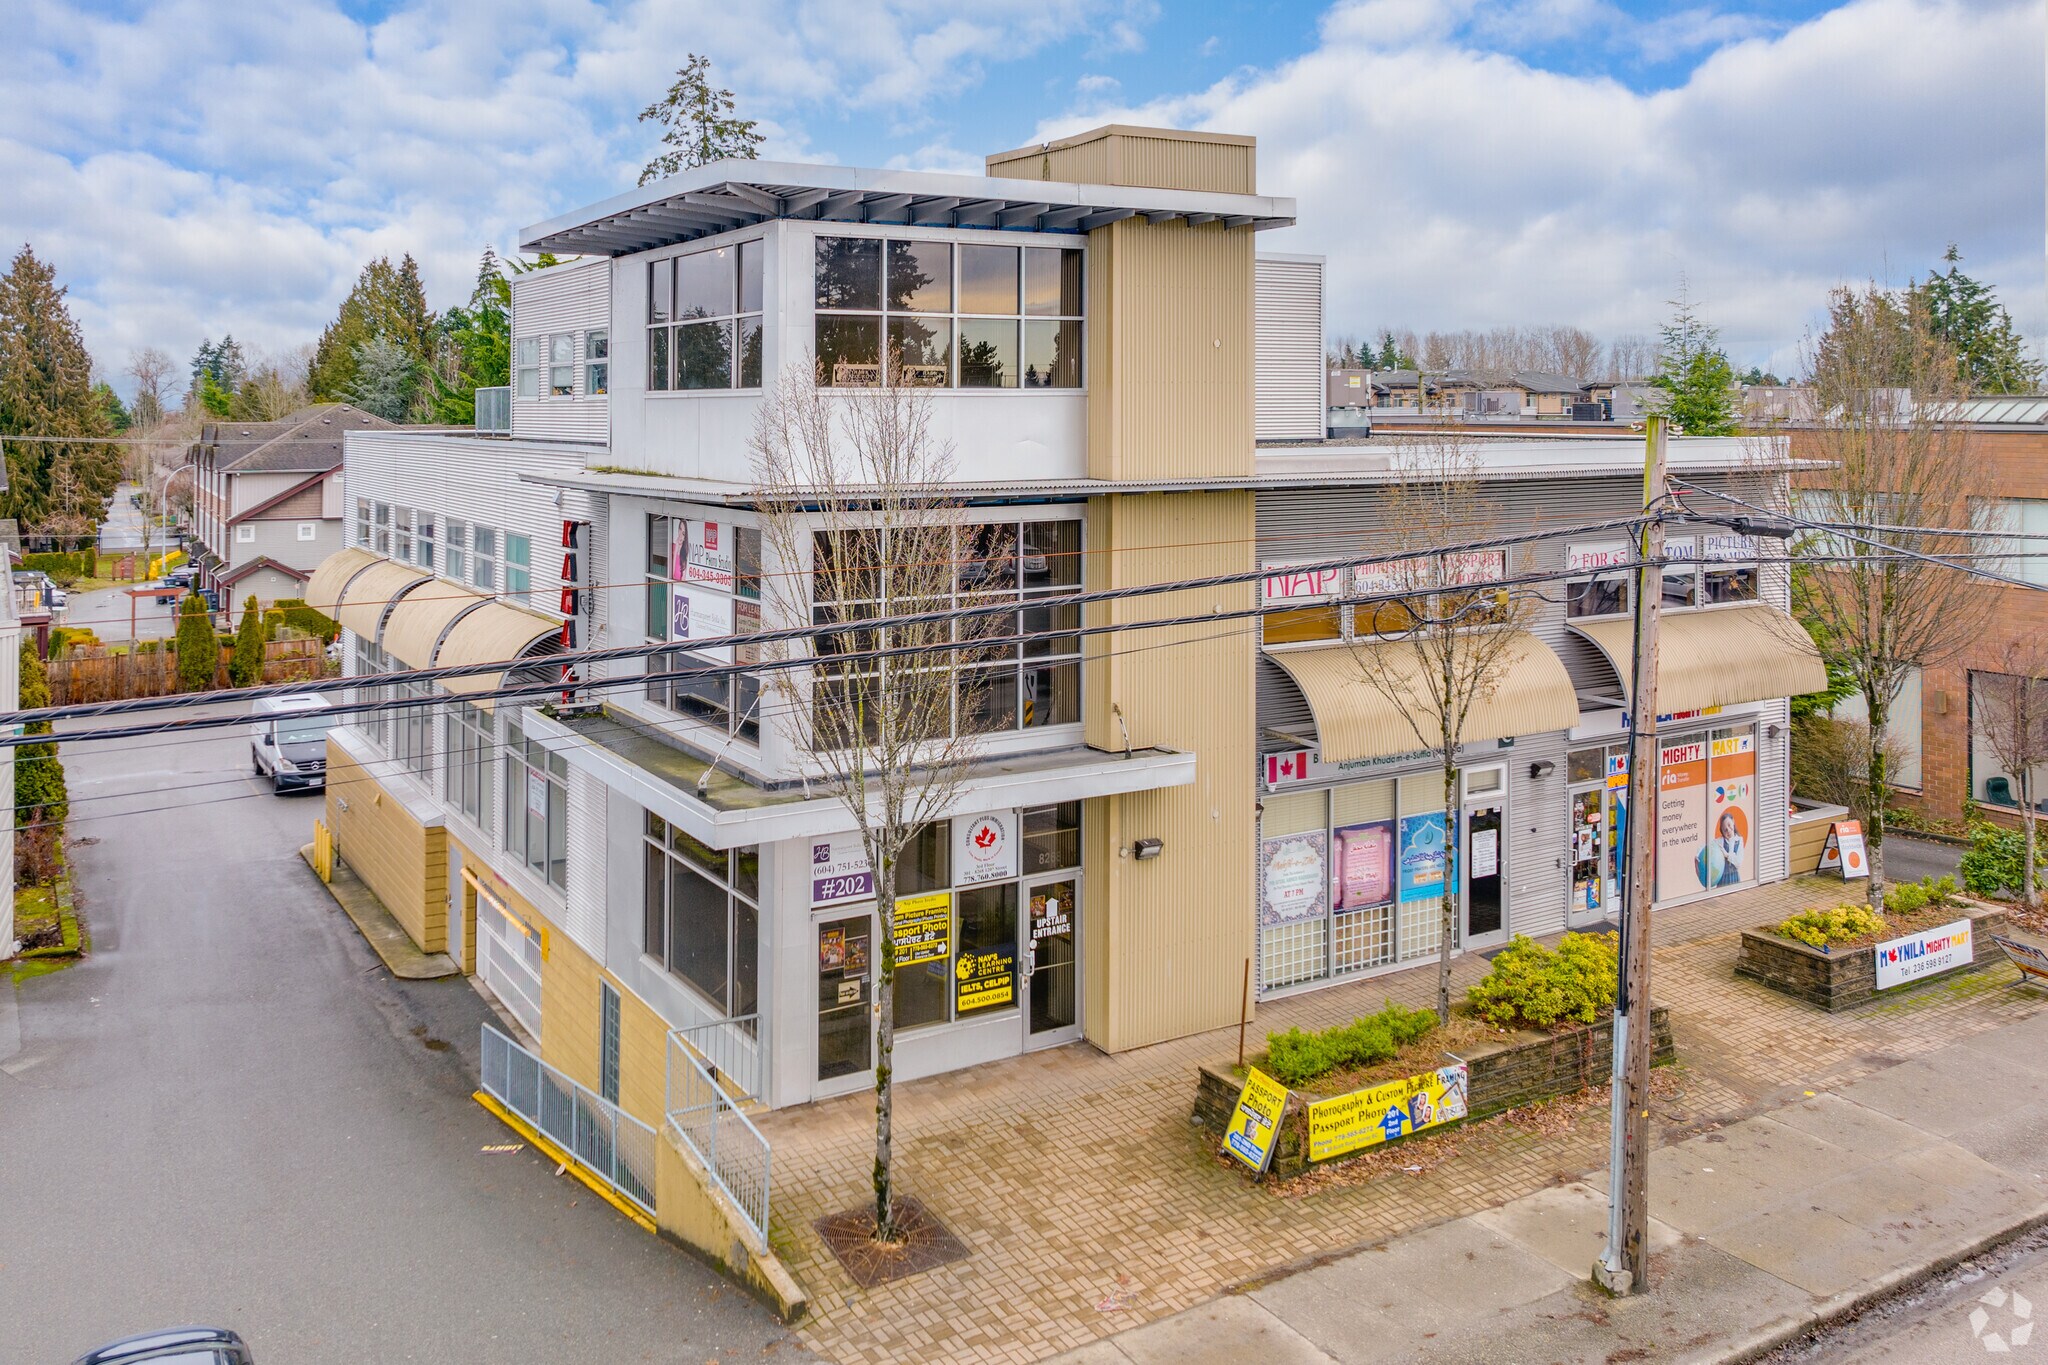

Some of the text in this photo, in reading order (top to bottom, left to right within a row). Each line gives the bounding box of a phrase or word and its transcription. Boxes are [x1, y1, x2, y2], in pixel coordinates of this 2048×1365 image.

[1664, 546, 1692, 560] TOM
[1582, 552, 1608, 569] FOR
[1613, 551, 1627, 565] $5
[1267, 566, 1338, 597] NAP
[1313, 753, 1319, 763] B
[1662, 738, 1740, 765] MIGHTY MART
[1338, 760, 1371, 771] Anjuman
[1661, 769, 1677, 785] ria
[1662, 799, 1685, 809] Getting
[1662, 813, 1682, 822] money
[1662, 822, 1697, 835] everywhere
[1840, 825, 1850, 833] ria
[1662, 833, 1698, 847] in the world
[813, 859, 868, 877] (604) 751-523
[963, 870, 1008, 883] 778.760.8000
[821, 875, 865, 899] #202
[1296, 888, 1304, 896] PM
[905, 911, 924, 919] Picture
[925, 907, 947, 917] Framing
[1036, 914, 1067, 928] UPSTAIR
[894, 926, 920, 939] ssport
[923, 922, 947, 933] Photo
[1033, 923, 1071, 939] ENTRANCE
[1926, 936, 1951, 955] MIGHTY
[1951, 930, 1969, 947] MART
[978, 953, 998, 962] NAV'S
[978, 957, 1013, 969] LEARNING
[978, 965, 1004, 976] CENTRE
[1900, 953, 1953, 976] Tel 236 598 9127
[961, 976, 1010, 994] IELTS, CELPIP
[961, 991, 1009, 1006] 604.500.0854
[1247, 1079, 1282, 1108] PASSPORT
[1366, 1093, 1373, 1105] &
[1247, 1093, 1272, 1117] Photo
[1386, 1108, 1400, 1119] 201
[1388, 1118, 1399, 1127] 2nd
[1386, 1126, 1400, 1135] Floor
[1314, 1138, 1333, 1148] Phone
